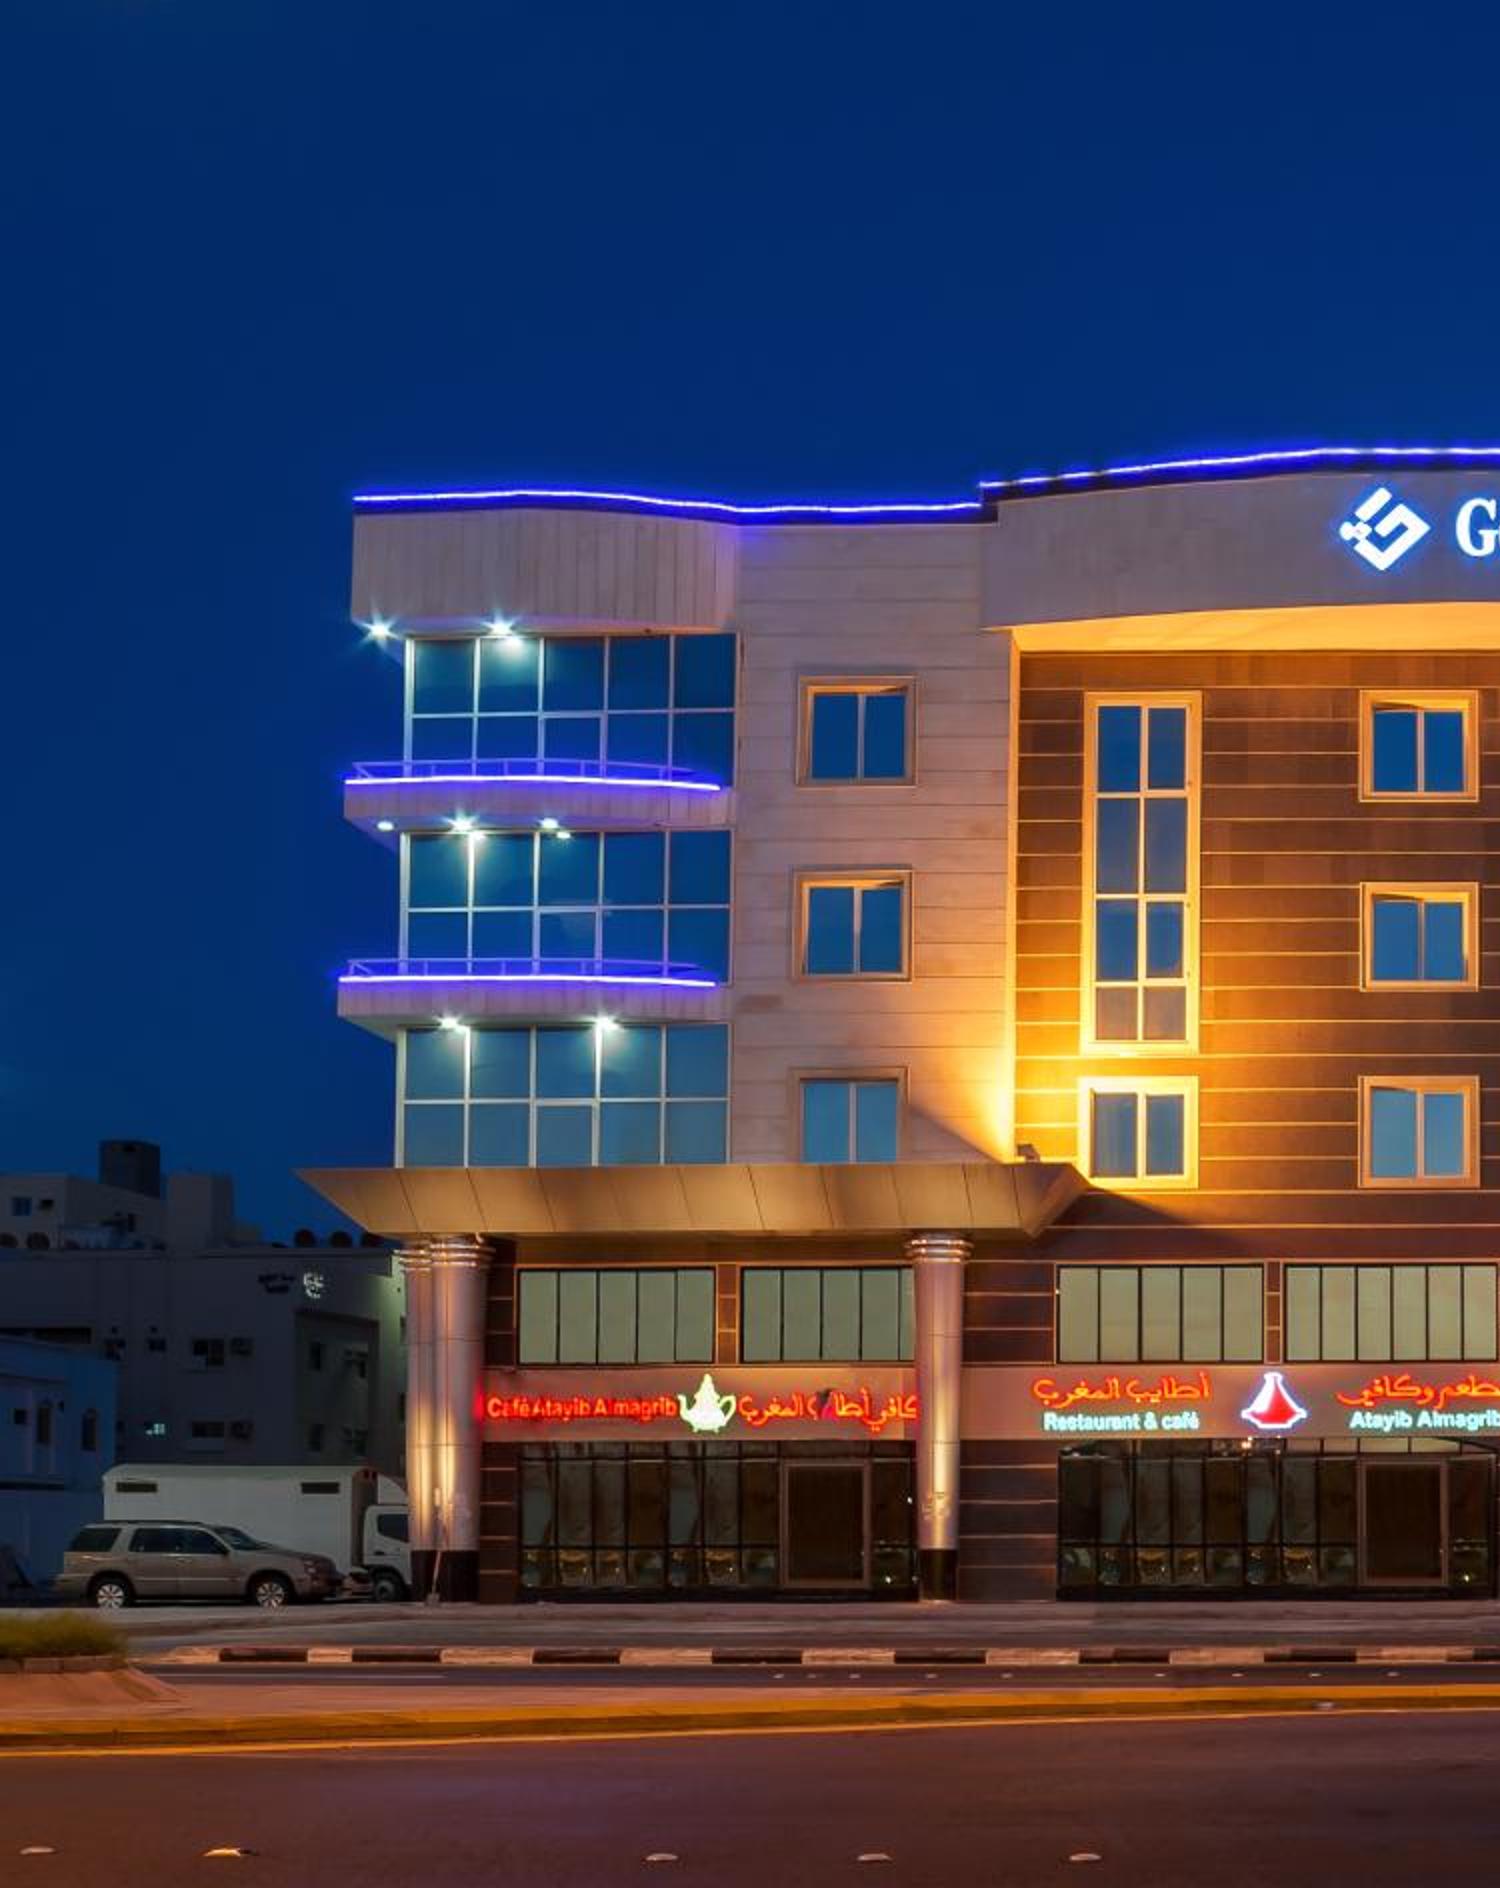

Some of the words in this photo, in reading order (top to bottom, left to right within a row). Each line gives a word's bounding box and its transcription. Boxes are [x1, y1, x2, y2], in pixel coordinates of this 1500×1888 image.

[1033, 1376, 1121, 1409] المغرب
[1126, 1371, 1210, 1404] أطايب
[1336, 1374, 1435, 1408] وكافي
[487, 1396, 530, 1418] Café
[1043, 1411, 1141, 1431] Restaurant
[1143, 1412, 1159, 1430] &
[1161, 1411, 1200, 1431] café
[1349, 1411, 1413, 1432] Atayib
